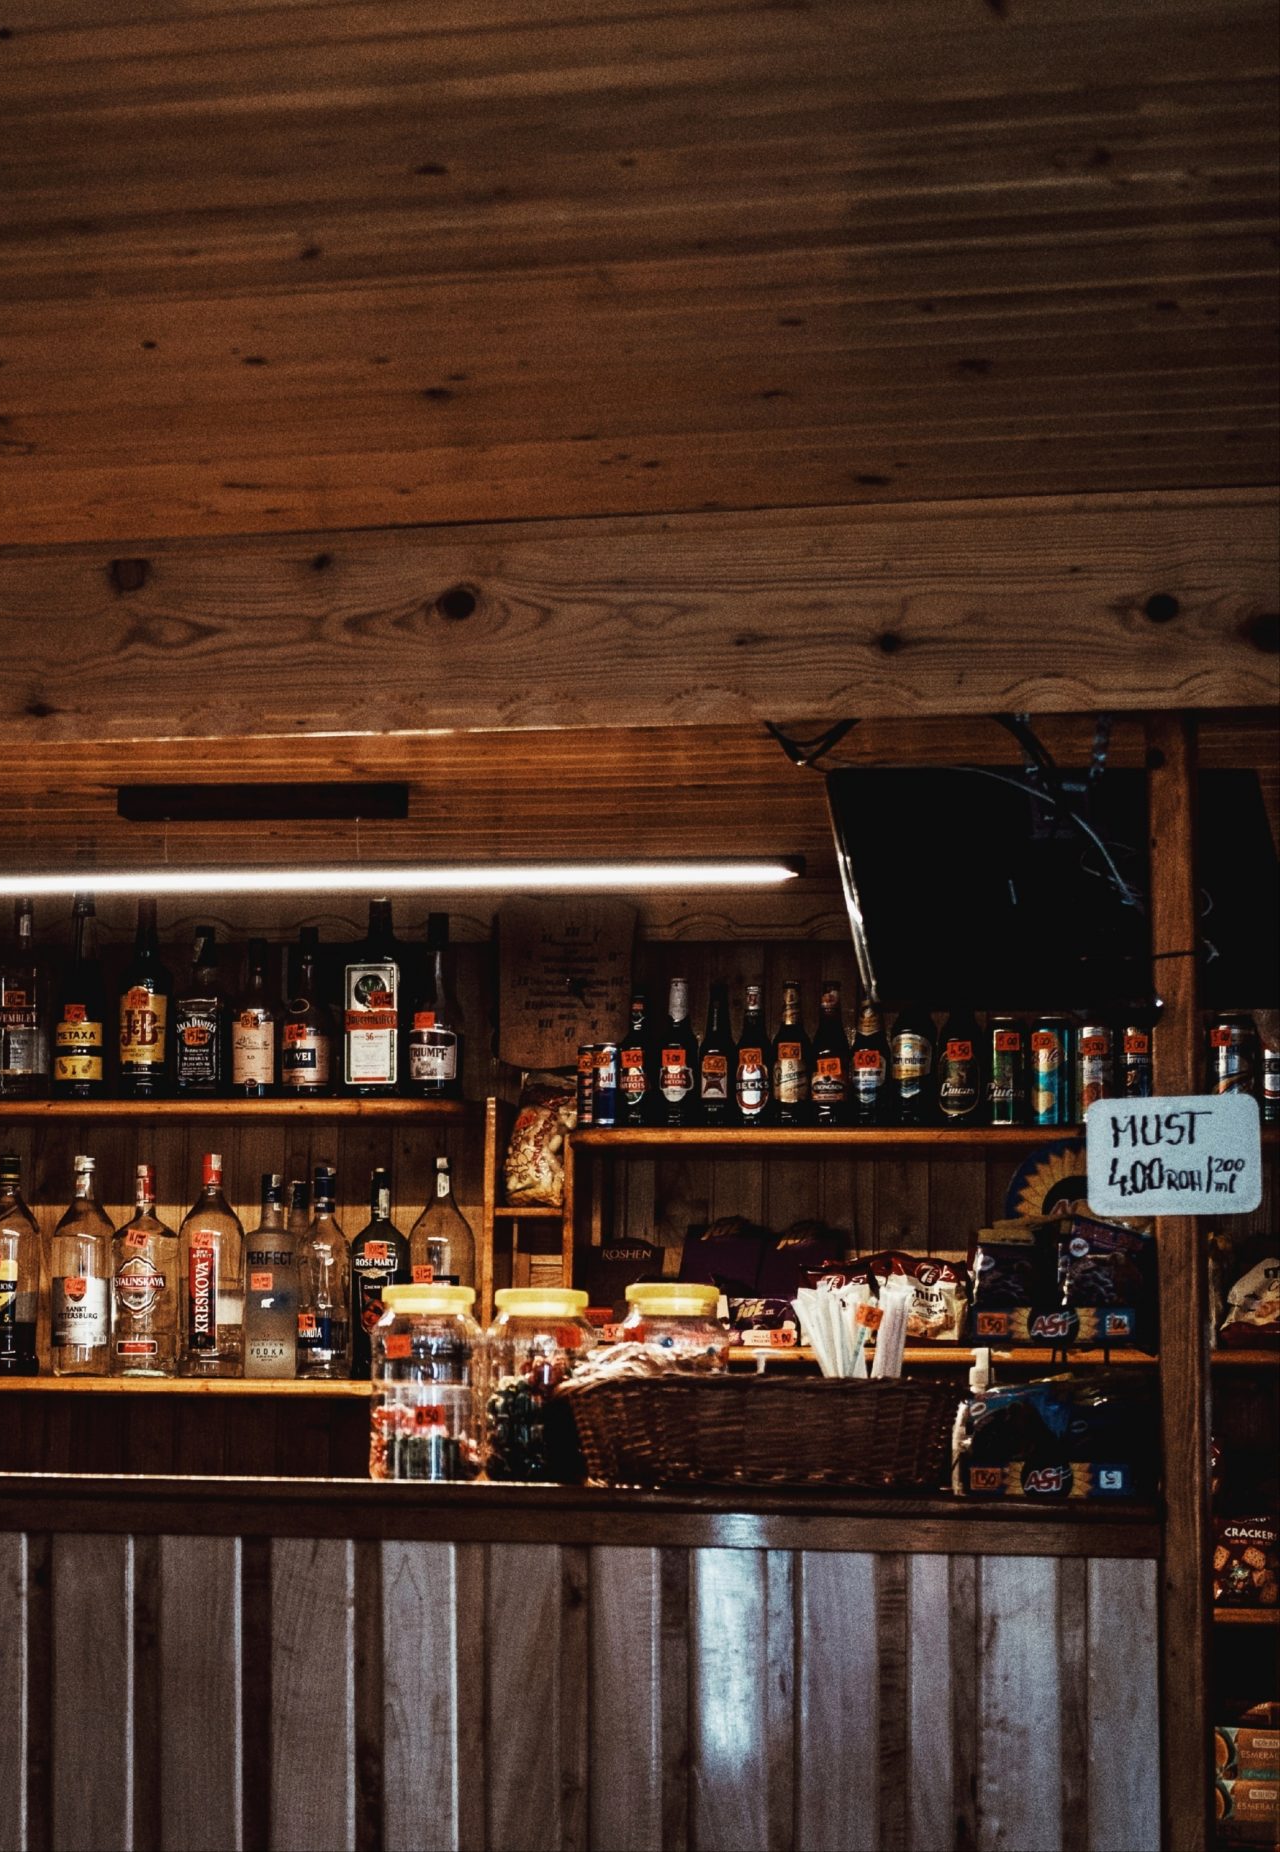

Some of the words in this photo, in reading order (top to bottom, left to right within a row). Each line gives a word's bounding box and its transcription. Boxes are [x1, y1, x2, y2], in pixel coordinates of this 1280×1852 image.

[176, 1022, 193, 1034] JACK
[57, 1031, 96, 1041] METAXA
[857, 1053, 877, 1067] 5.00
[1111, 1111, 1212, 1148] MUST
[247, 1251, 294, 1266] PERFECT
[601, 1247, 653, 1261] ROSHEN
[355, 1258, 373, 1267] ROSE
[373, 1258, 396, 1267] MARY
[115, 1275, 165, 1288] STALINSKAYA
[195, 1261, 210, 1334] KRESKOVA
[773, 1333, 792, 1344] 3.00
[250, 1348, 284, 1357] VODKA
